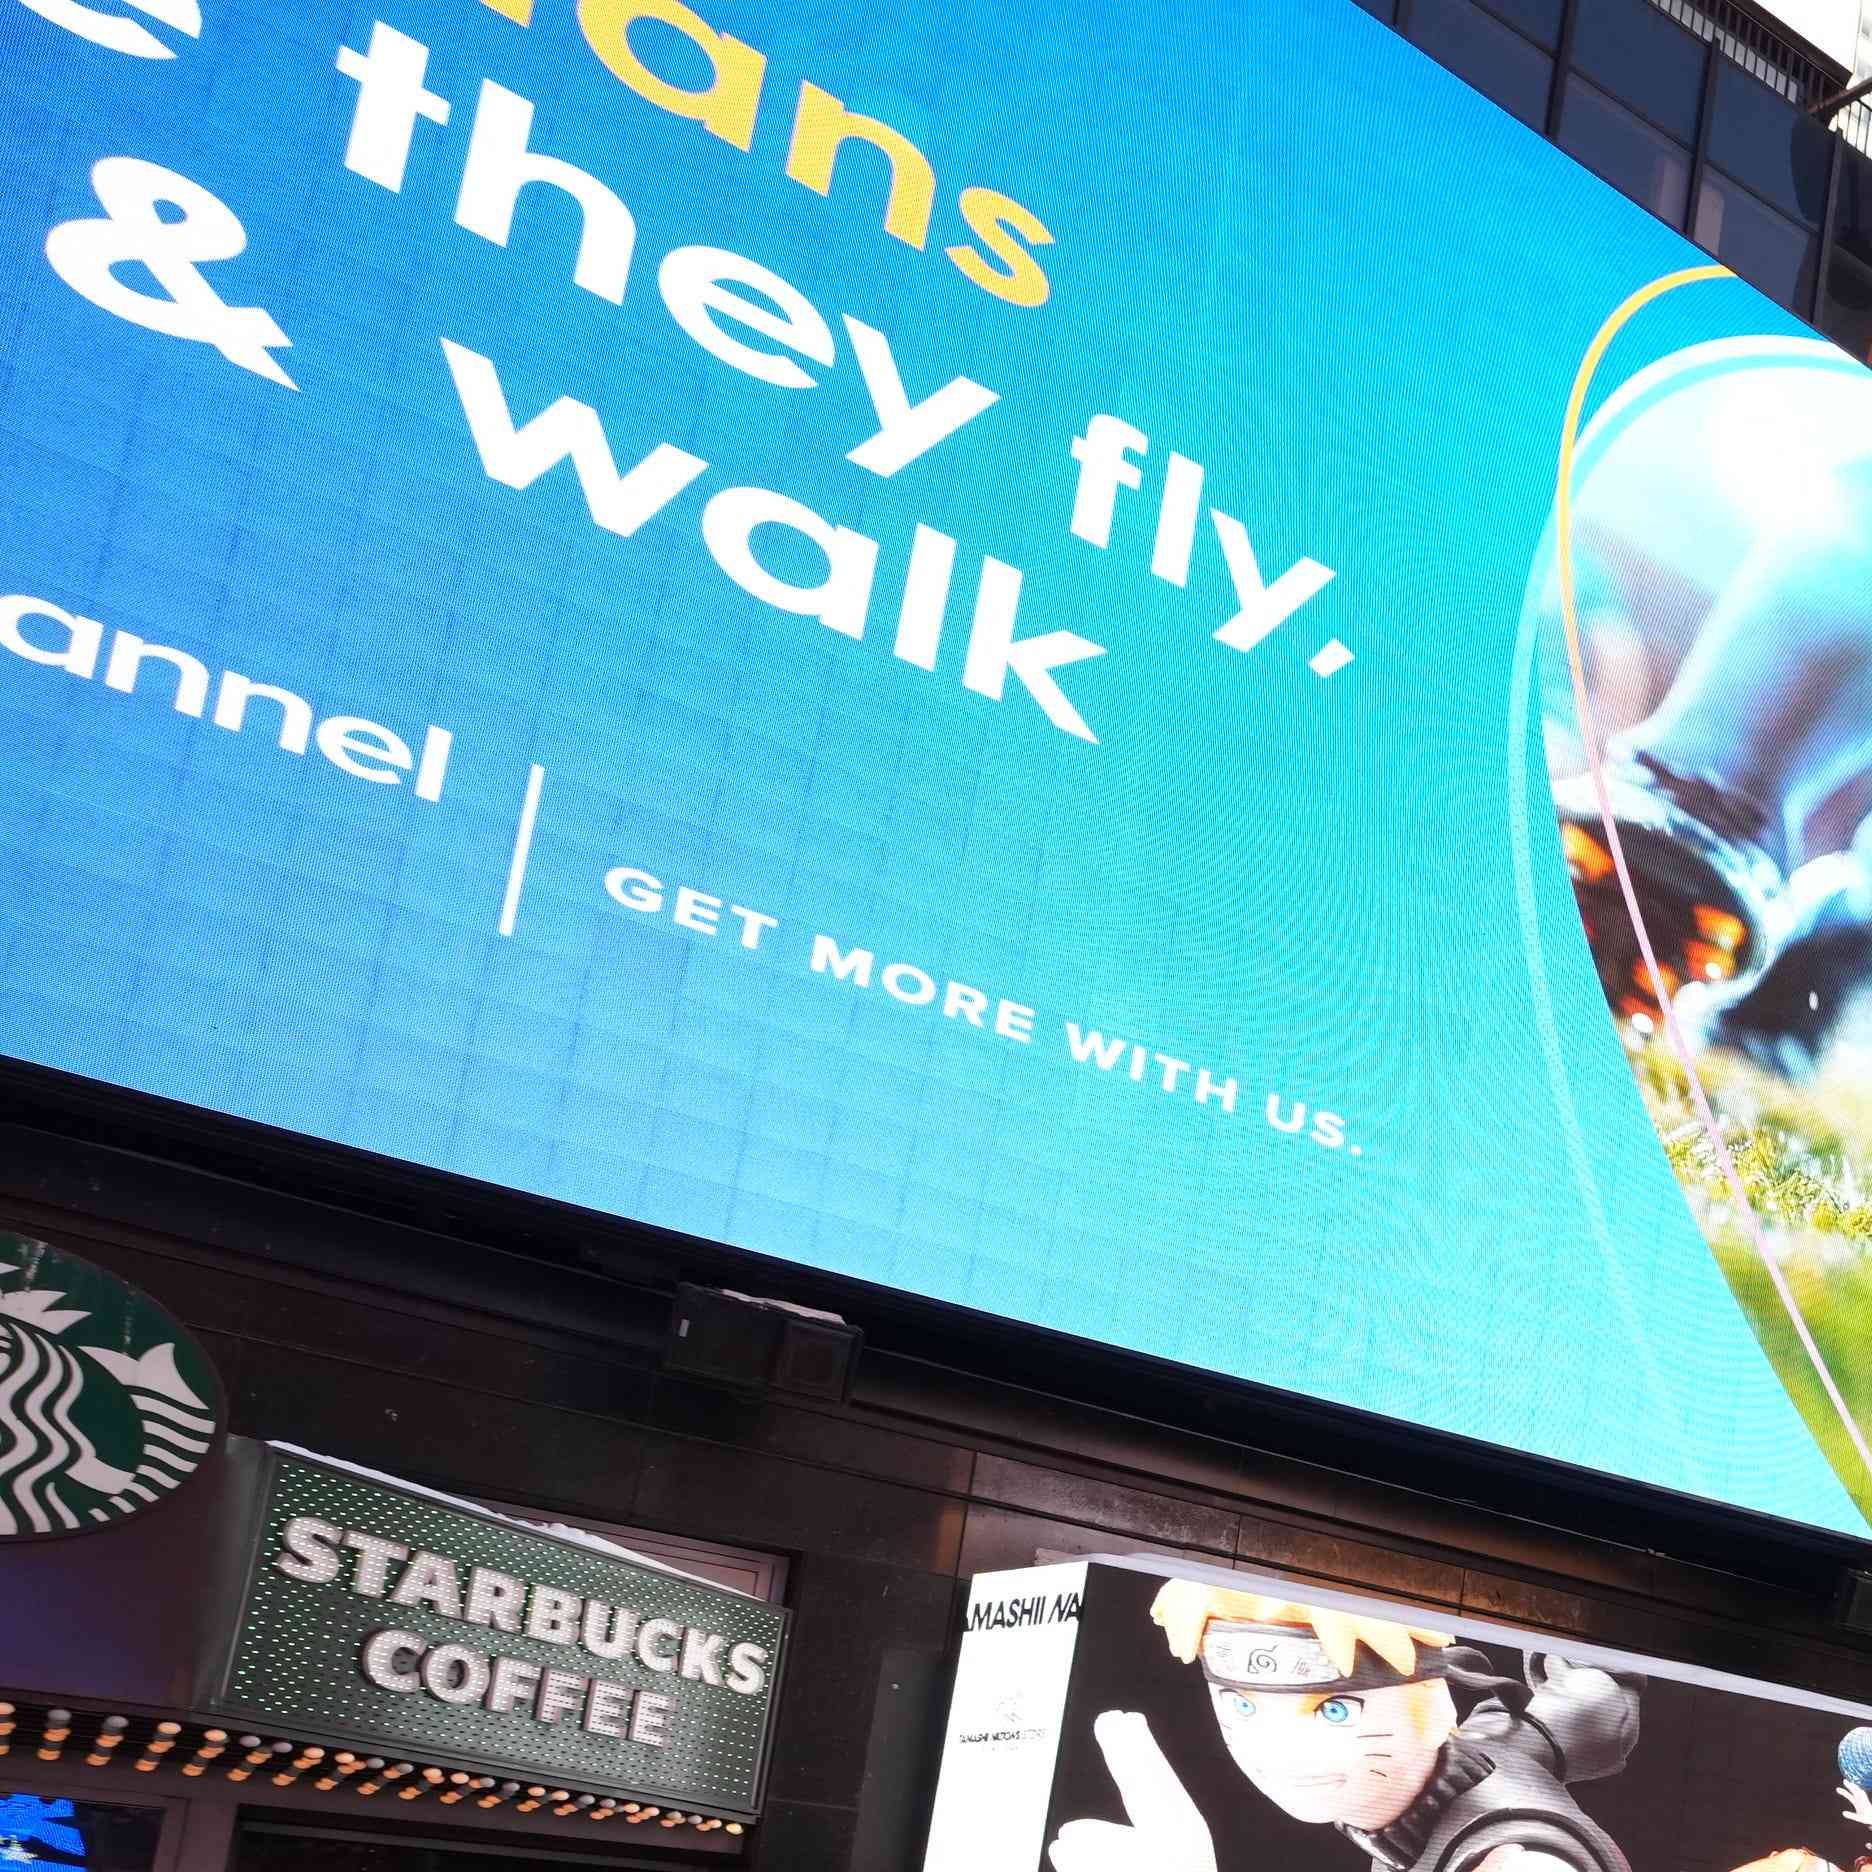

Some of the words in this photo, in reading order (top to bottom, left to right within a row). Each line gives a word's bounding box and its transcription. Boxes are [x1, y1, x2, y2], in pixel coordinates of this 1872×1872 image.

[478, 0, 1058, 307] ans
[45, 155, 302, 393] &
[440, 336, 1109, 746] walk
[336, 19, 1002, 479] they
[1068, 413, 1355, 679] fly,
[0, 593, 454, 805] annel
[604, 866, 779, 951] GET
[808, 933, 1037, 1044] MORE
[1064, 1021, 1240, 1113] WITH
[1264, 1093, 1364, 1157] US.
[275, 1514, 769, 1697] STARBUCKS
[361, 1628, 678, 1750] COFFEE
